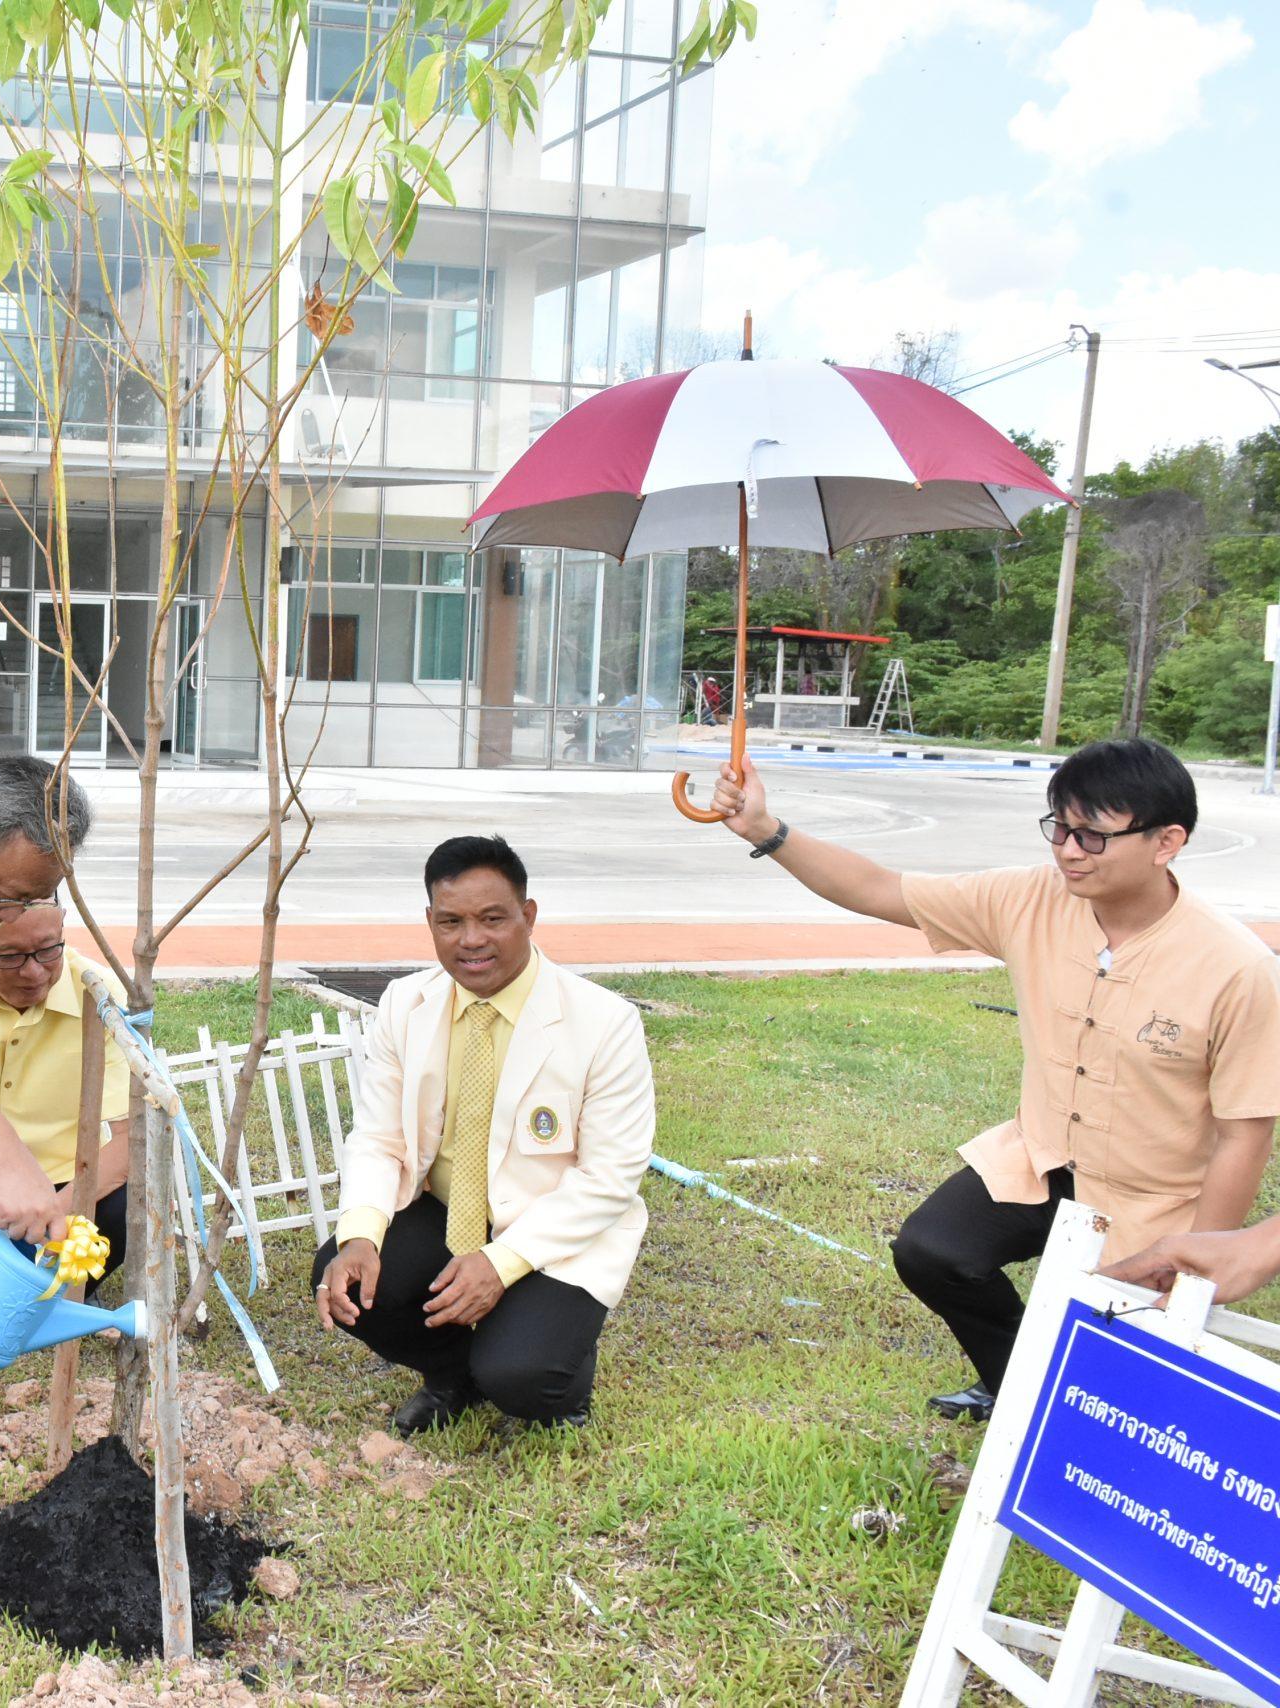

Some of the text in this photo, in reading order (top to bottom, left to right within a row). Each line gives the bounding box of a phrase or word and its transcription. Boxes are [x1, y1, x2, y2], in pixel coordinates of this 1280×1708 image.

[1064, 1385, 1219, 1481] ศาสตราจารย์พิเศษ
